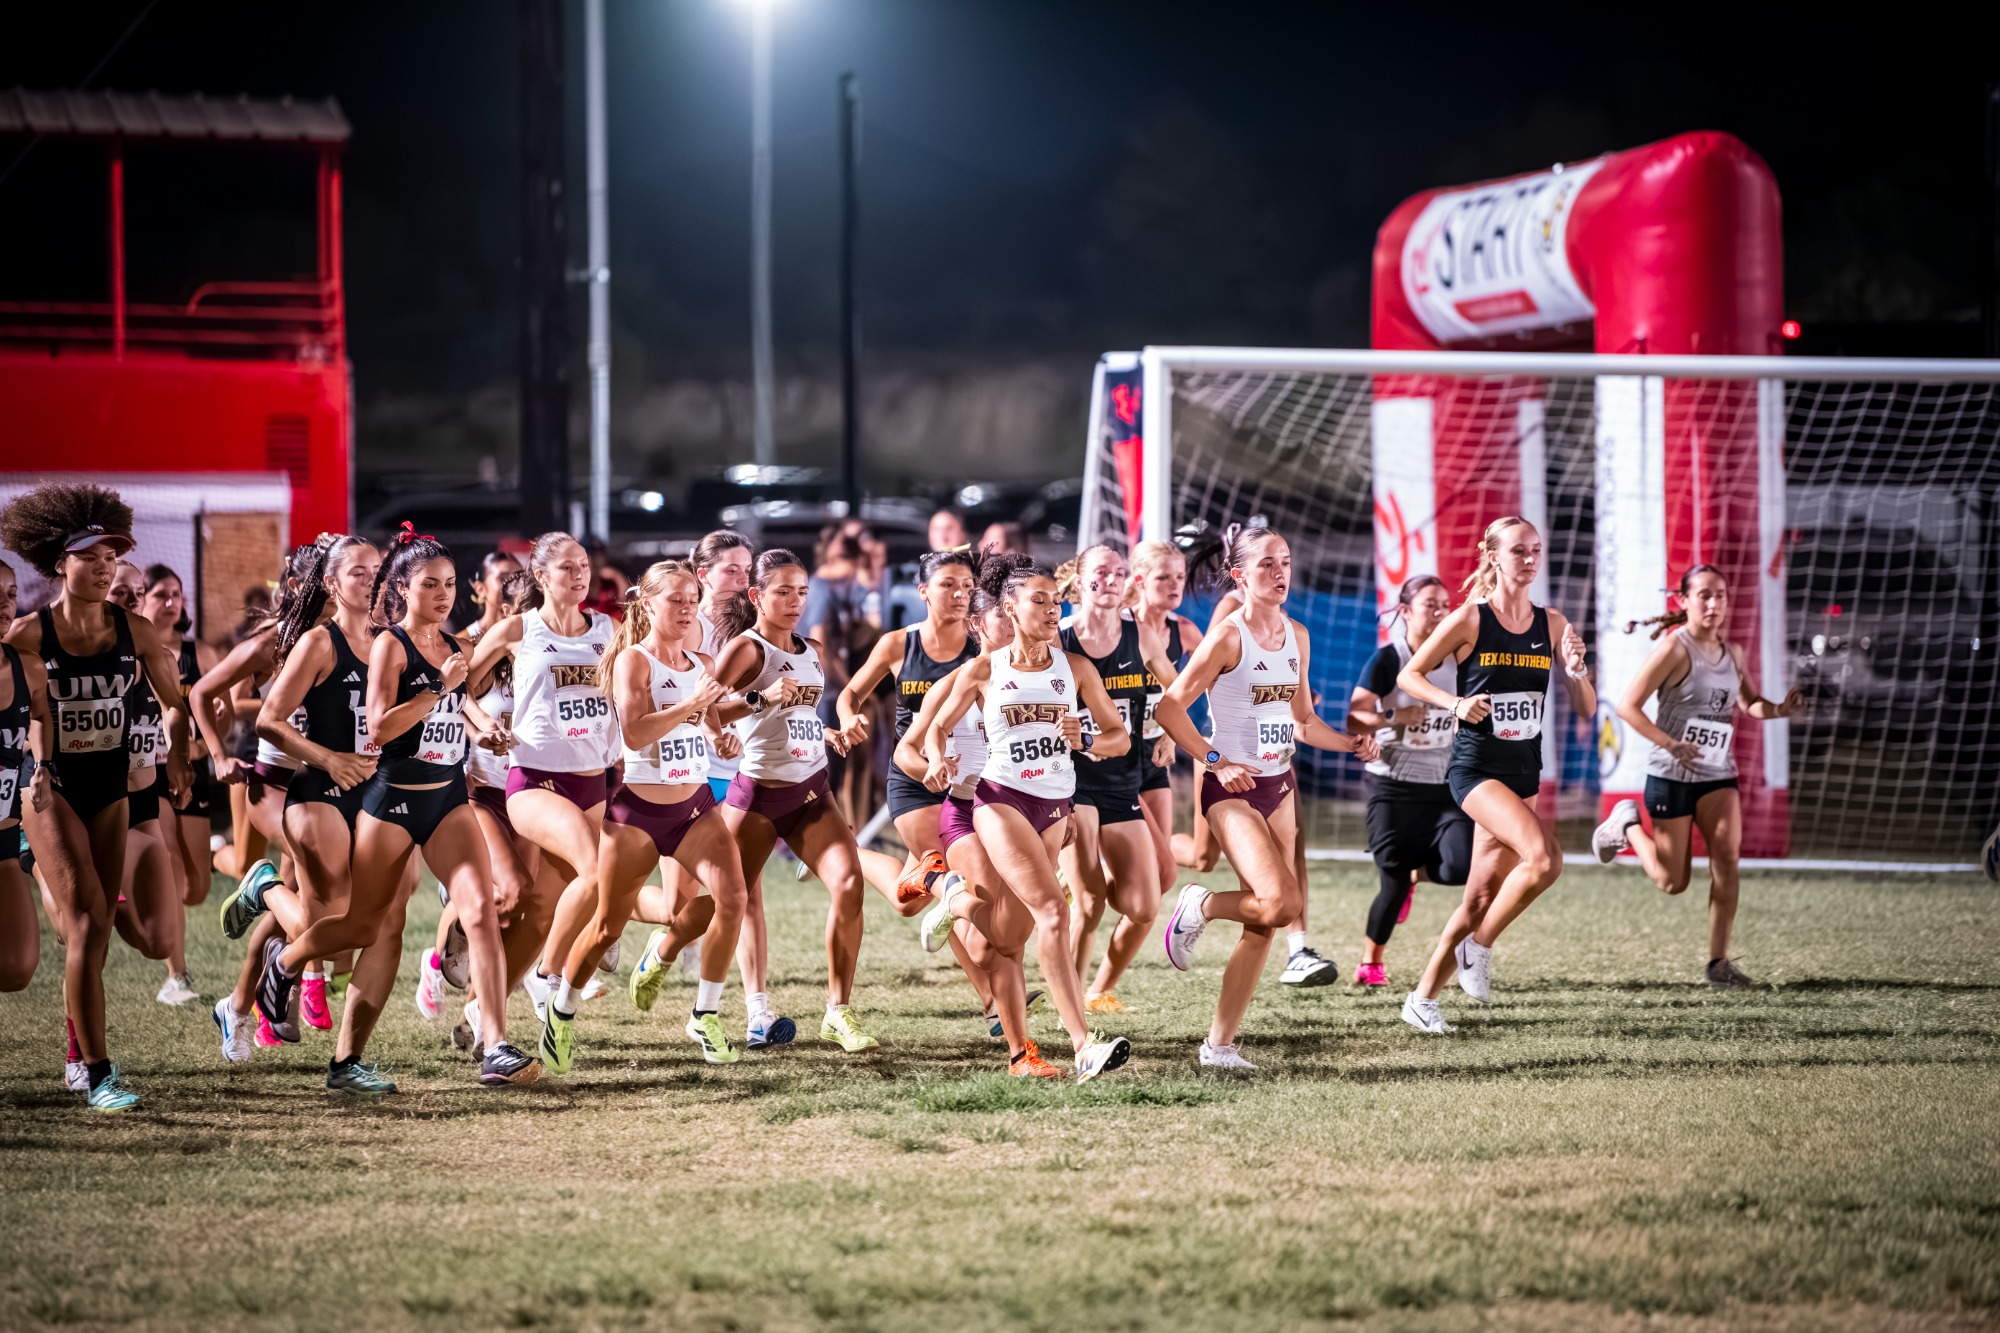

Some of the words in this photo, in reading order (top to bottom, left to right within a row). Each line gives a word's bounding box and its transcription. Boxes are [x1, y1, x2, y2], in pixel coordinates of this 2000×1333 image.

[1479, 652, 1512, 667] TEXAS
[48, 674, 135, 701] UIW
[550, 664, 600, 689] TXS
[62, 707, 123, 733] 5500
[559, 697, 609, 722] 5585
[1493, 699, 1538, 722] 5561
[423, 721, 464, 744] 5507
[567, 727, 589, 738] iRUN
[788, 719, 824, 742] 5583
[1259, 723, 1295, 745] 5580
[1684, 725, 1729, 750] 5551
[130, 732, 156, 754] 05
[660, 735, 705, 762] 5576
[1009, 736, 1067, 764] 5584
[668, 768, 690, 780] iRUN
[1020, 768, 1045, 780] iRUN
[0, 778, 14, 801] 3
